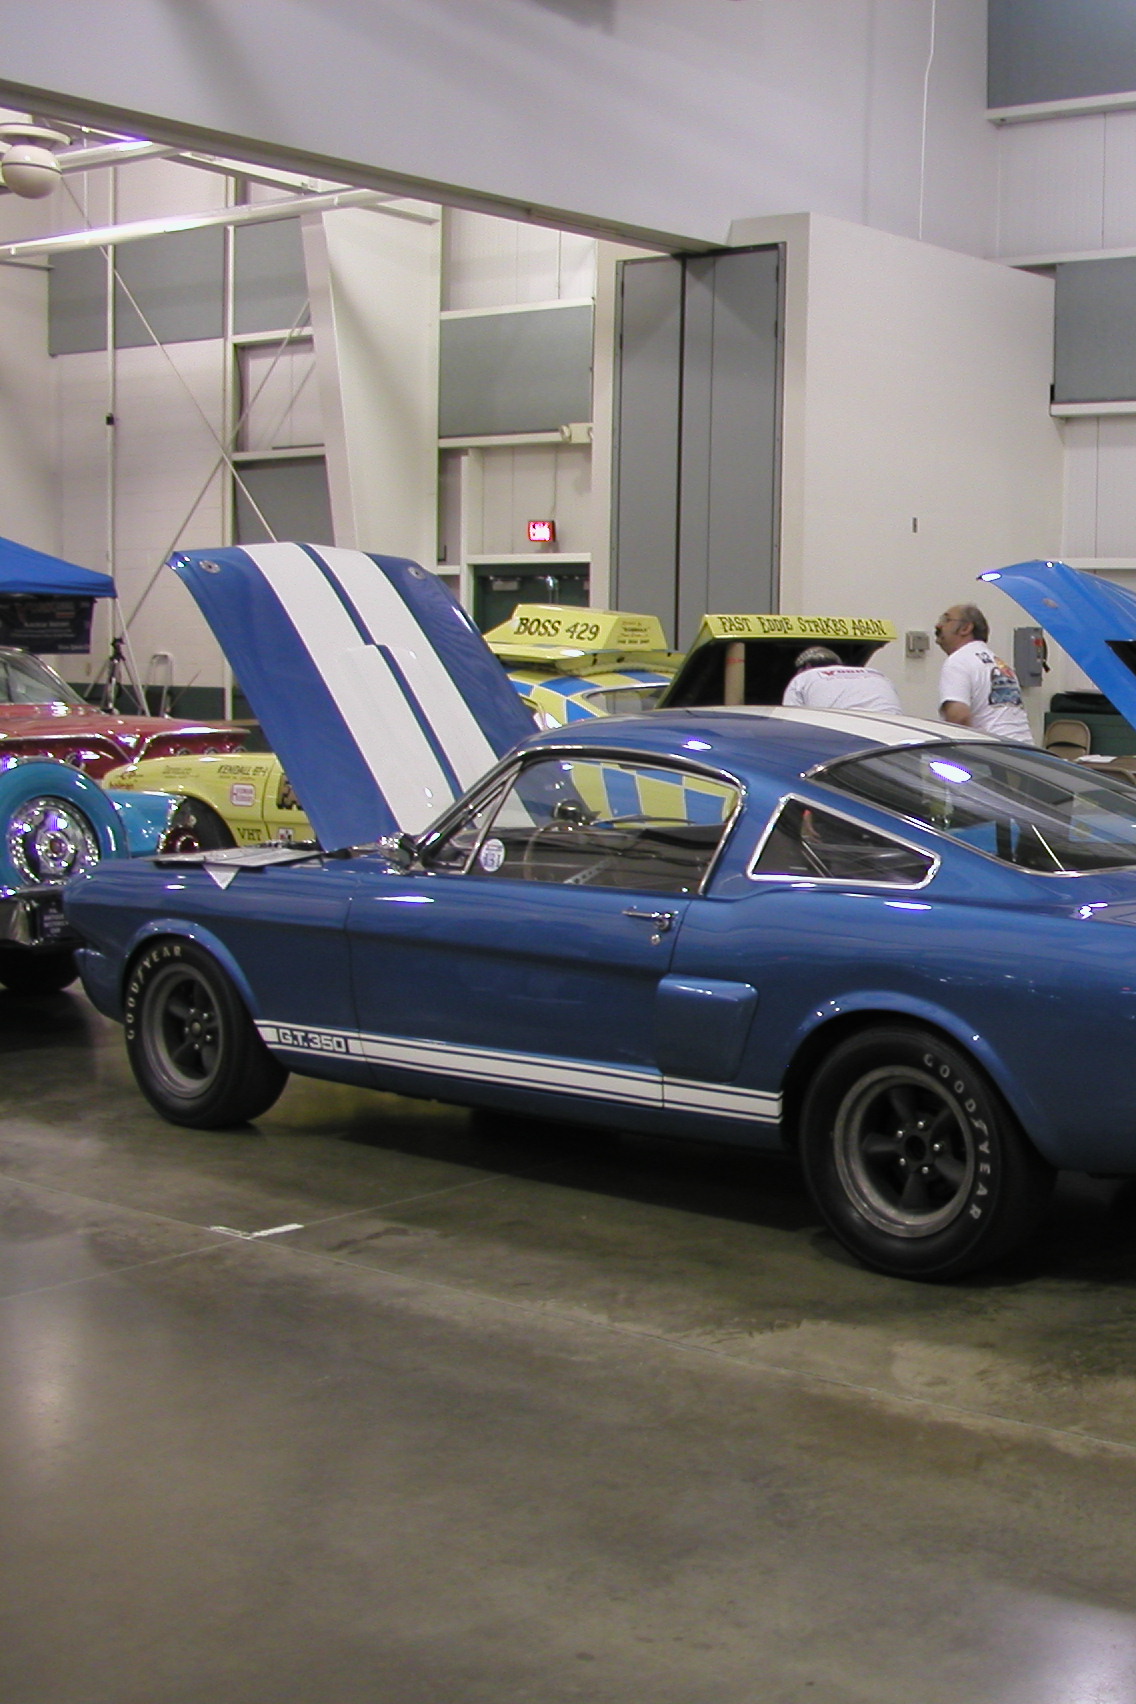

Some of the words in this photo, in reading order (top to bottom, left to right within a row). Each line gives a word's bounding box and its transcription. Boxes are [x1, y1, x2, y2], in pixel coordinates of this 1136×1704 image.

[514, 617, 562, 637] BOSS
[565, 622, 600, 641] 429
[717, 616, 752, 633] FAST
[757, 616, 793, 634] EDDIE
[797, 616, 849, 635] STRIKES
[851, 619, 887, 636] AGAIN
[237, 828, 262, 841] VHT
[923, 1053, 991, 1220] GOODYEAR
